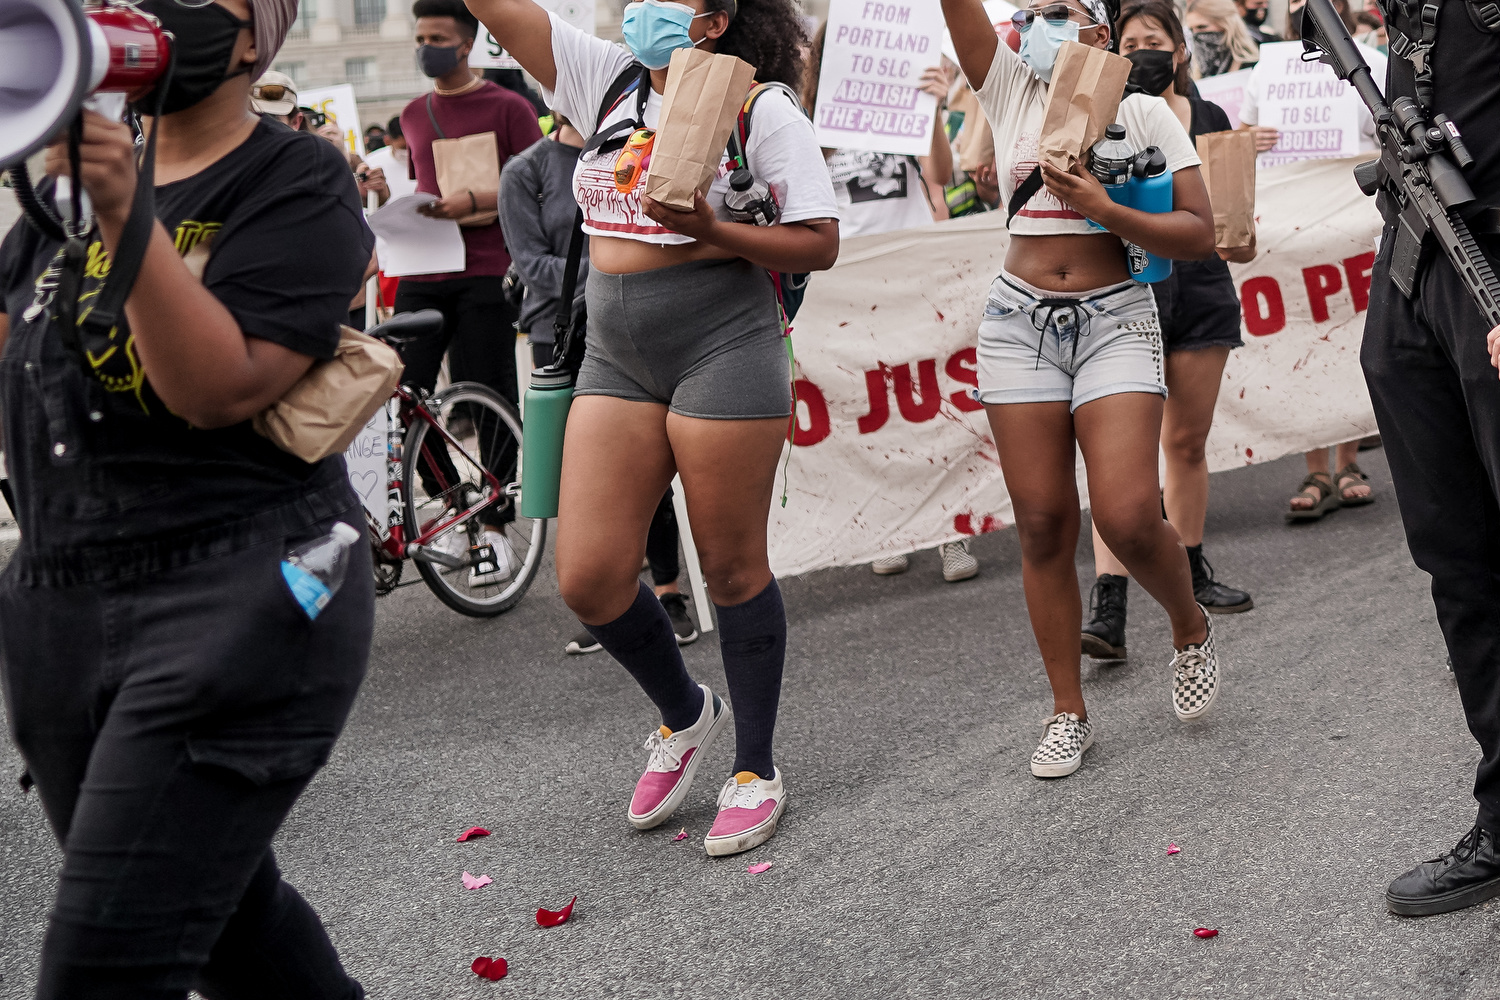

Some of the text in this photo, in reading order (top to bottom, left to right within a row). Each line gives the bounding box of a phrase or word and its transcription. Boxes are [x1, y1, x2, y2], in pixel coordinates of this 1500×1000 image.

[862, 0, 911, 25] FROM
[835, 24, 930, 54] PORTLAND
[851, 54, 911, 78] TO SLC
[833, 79, 919, 110] ABOLISH
[1267, 81, 1345, 101] PORTLAND
[819, 103, 929, 138] THE POLICE
[1281, 106, 1331, 125] TO SLC
